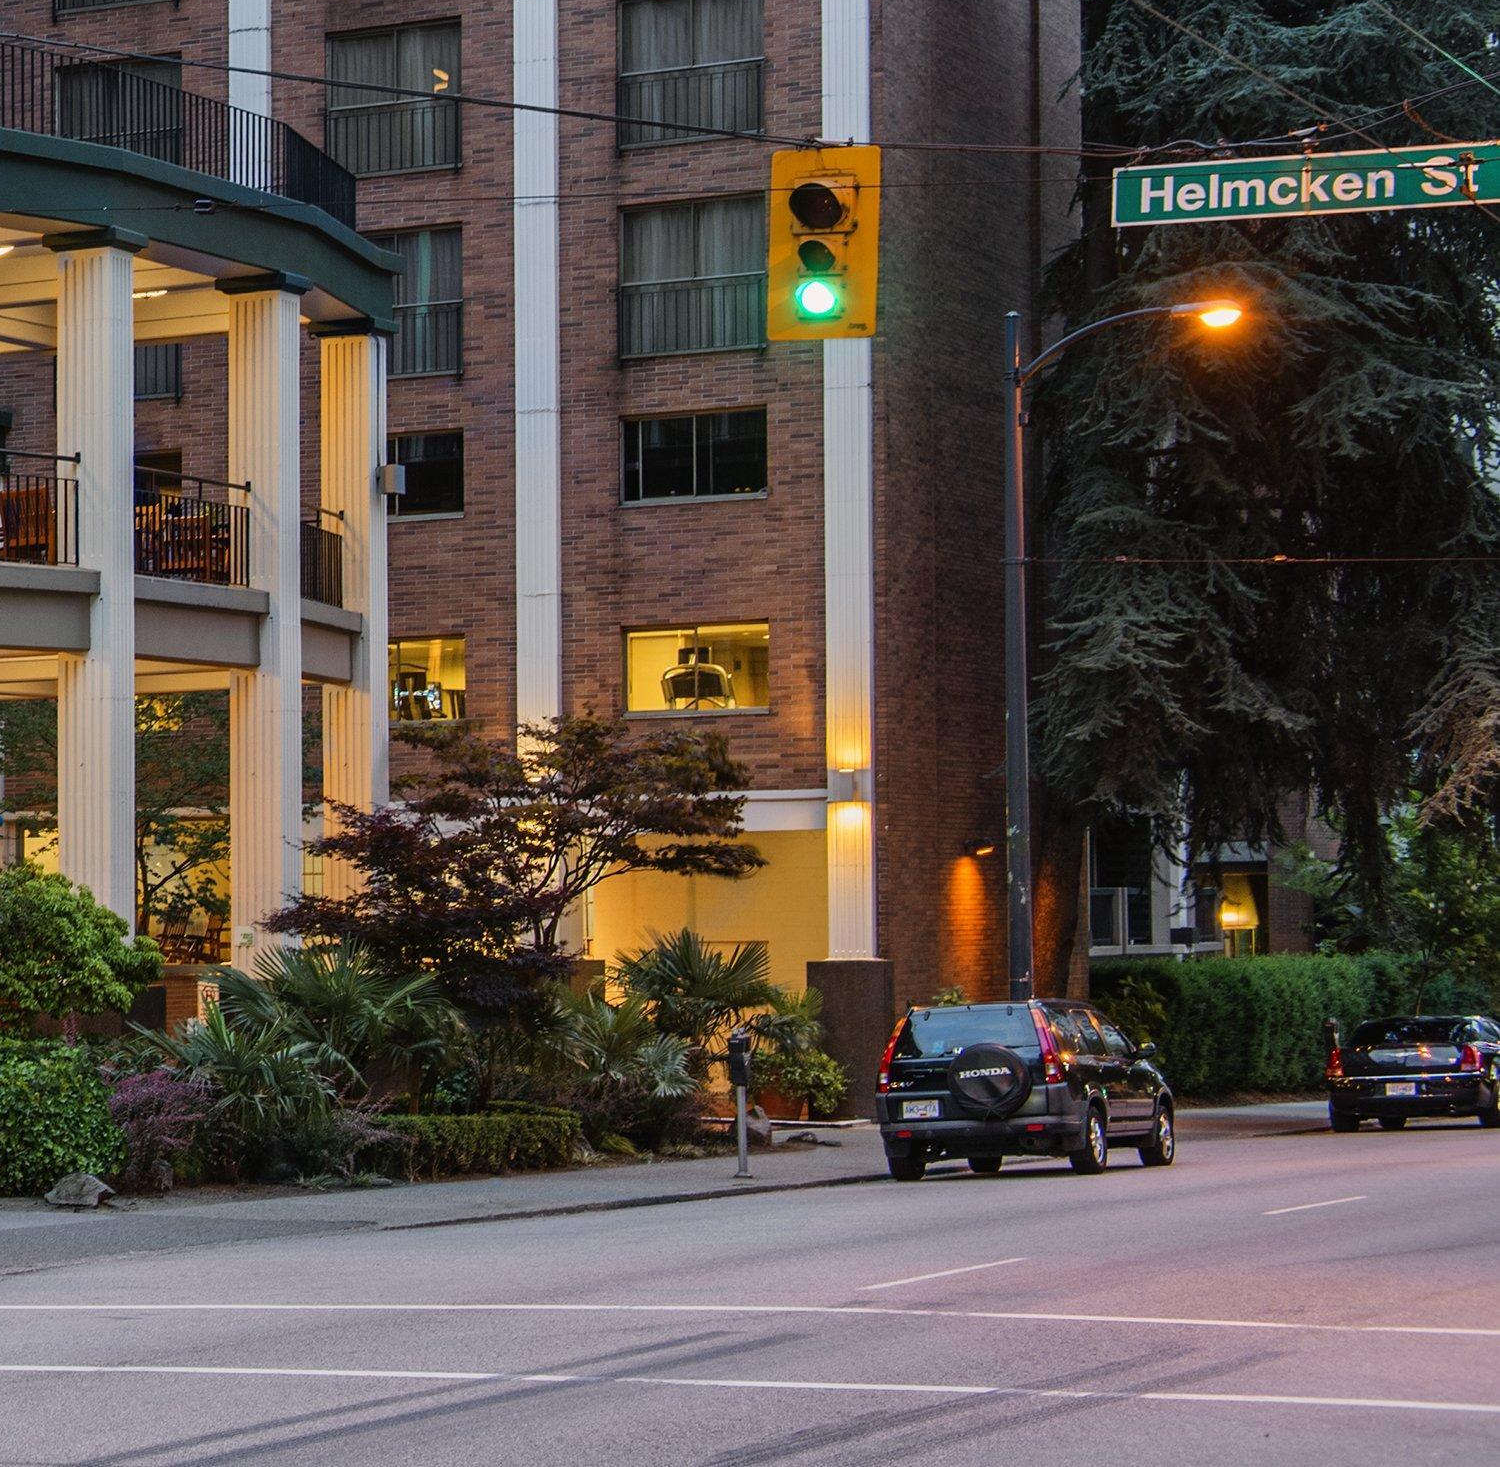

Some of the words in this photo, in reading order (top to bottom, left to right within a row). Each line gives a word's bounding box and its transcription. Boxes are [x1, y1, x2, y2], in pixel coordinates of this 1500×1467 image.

[1140, 169, 1395, 214] Helmcken
[1421, 156, 1480, 197] St
[959, 1067, 1012, 1079] HONDA
